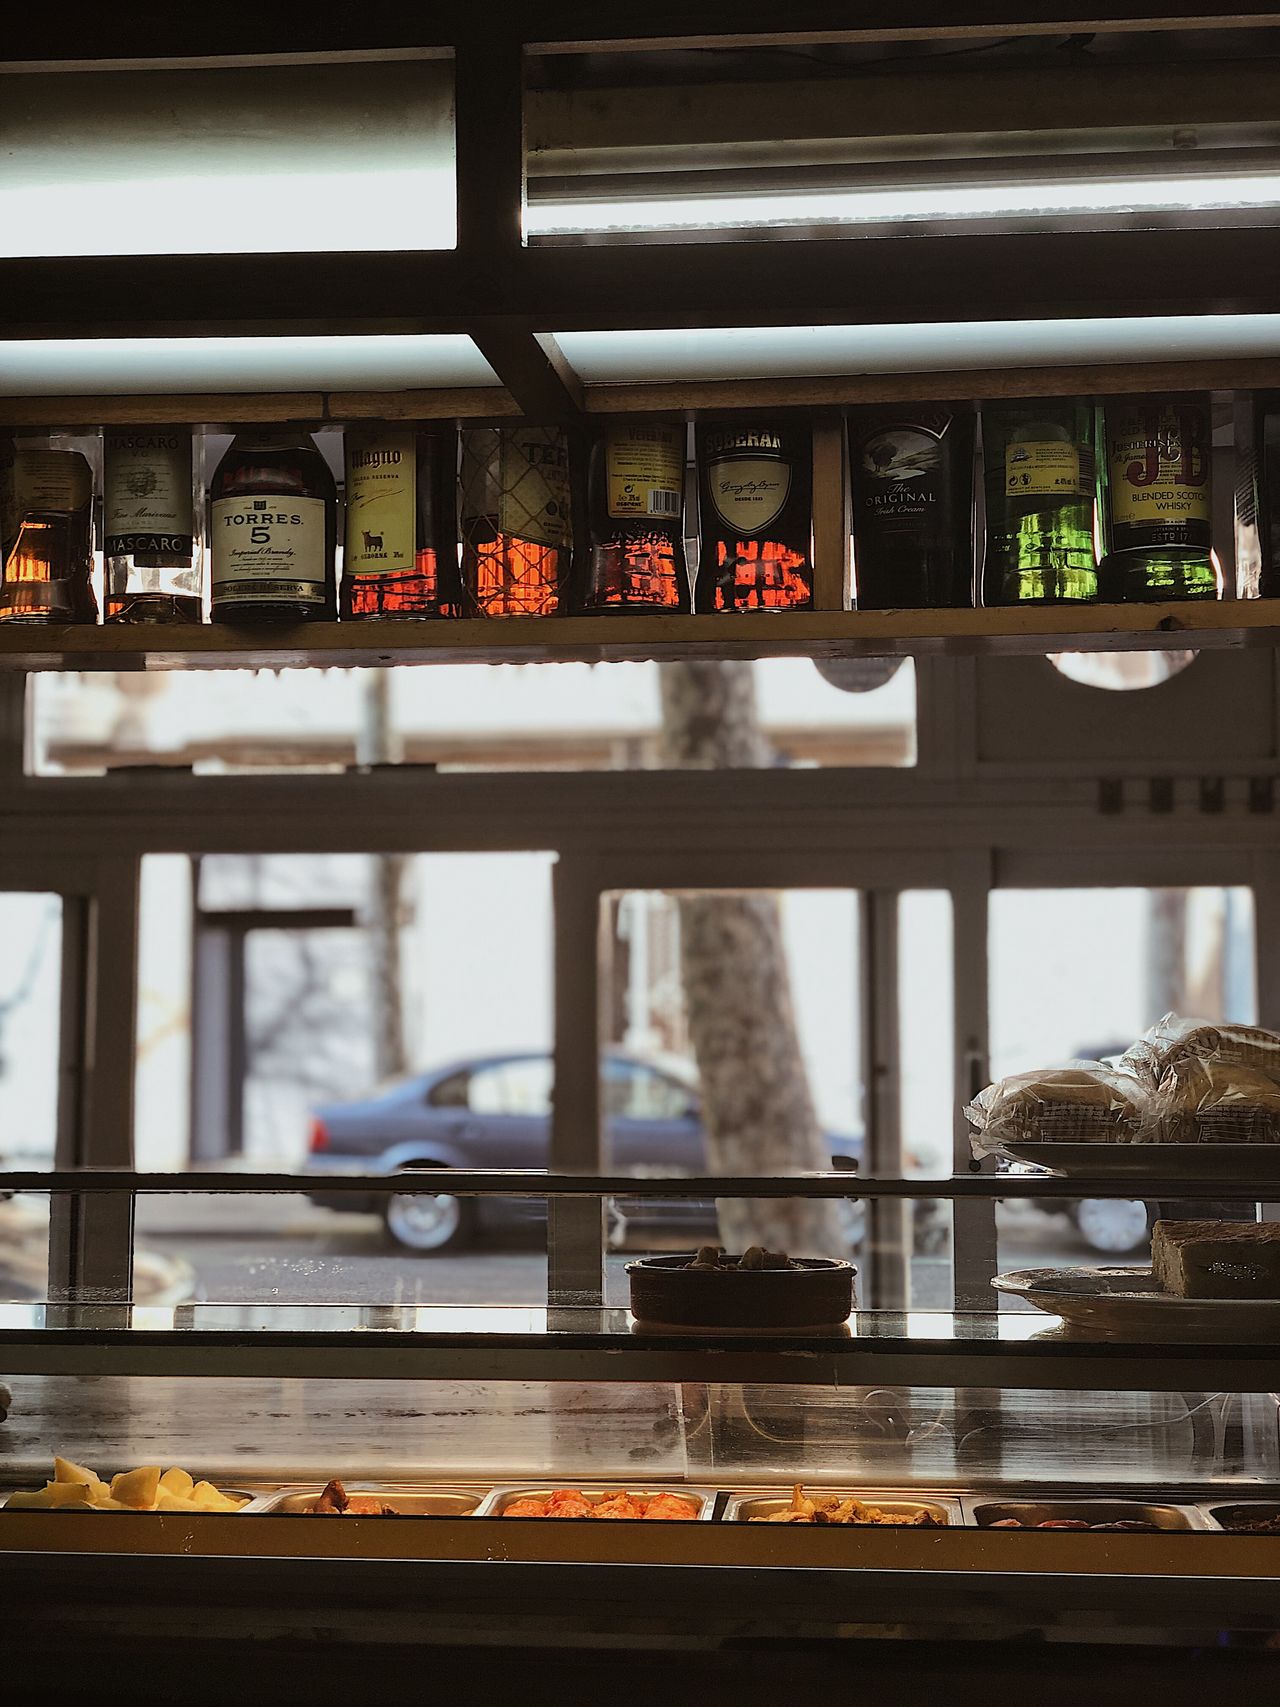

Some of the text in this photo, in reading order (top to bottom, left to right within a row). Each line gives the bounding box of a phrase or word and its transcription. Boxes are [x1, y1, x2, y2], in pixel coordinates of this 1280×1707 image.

[704, 430, 783, 453] SOBERAN
[352, 449, 402, 468] Magno
[886, 483, 912, 494] The
[866, 492, 937, 506] ORIGINAL
[1132, 491, 1174, 502] BLENDED
[873, 504, 926, 517] Irish Cream
[1155, 501, 1192, 512] WHISKY
[250, 526, 271, 544] 5
[228, 548, 261, 559] Imperial
